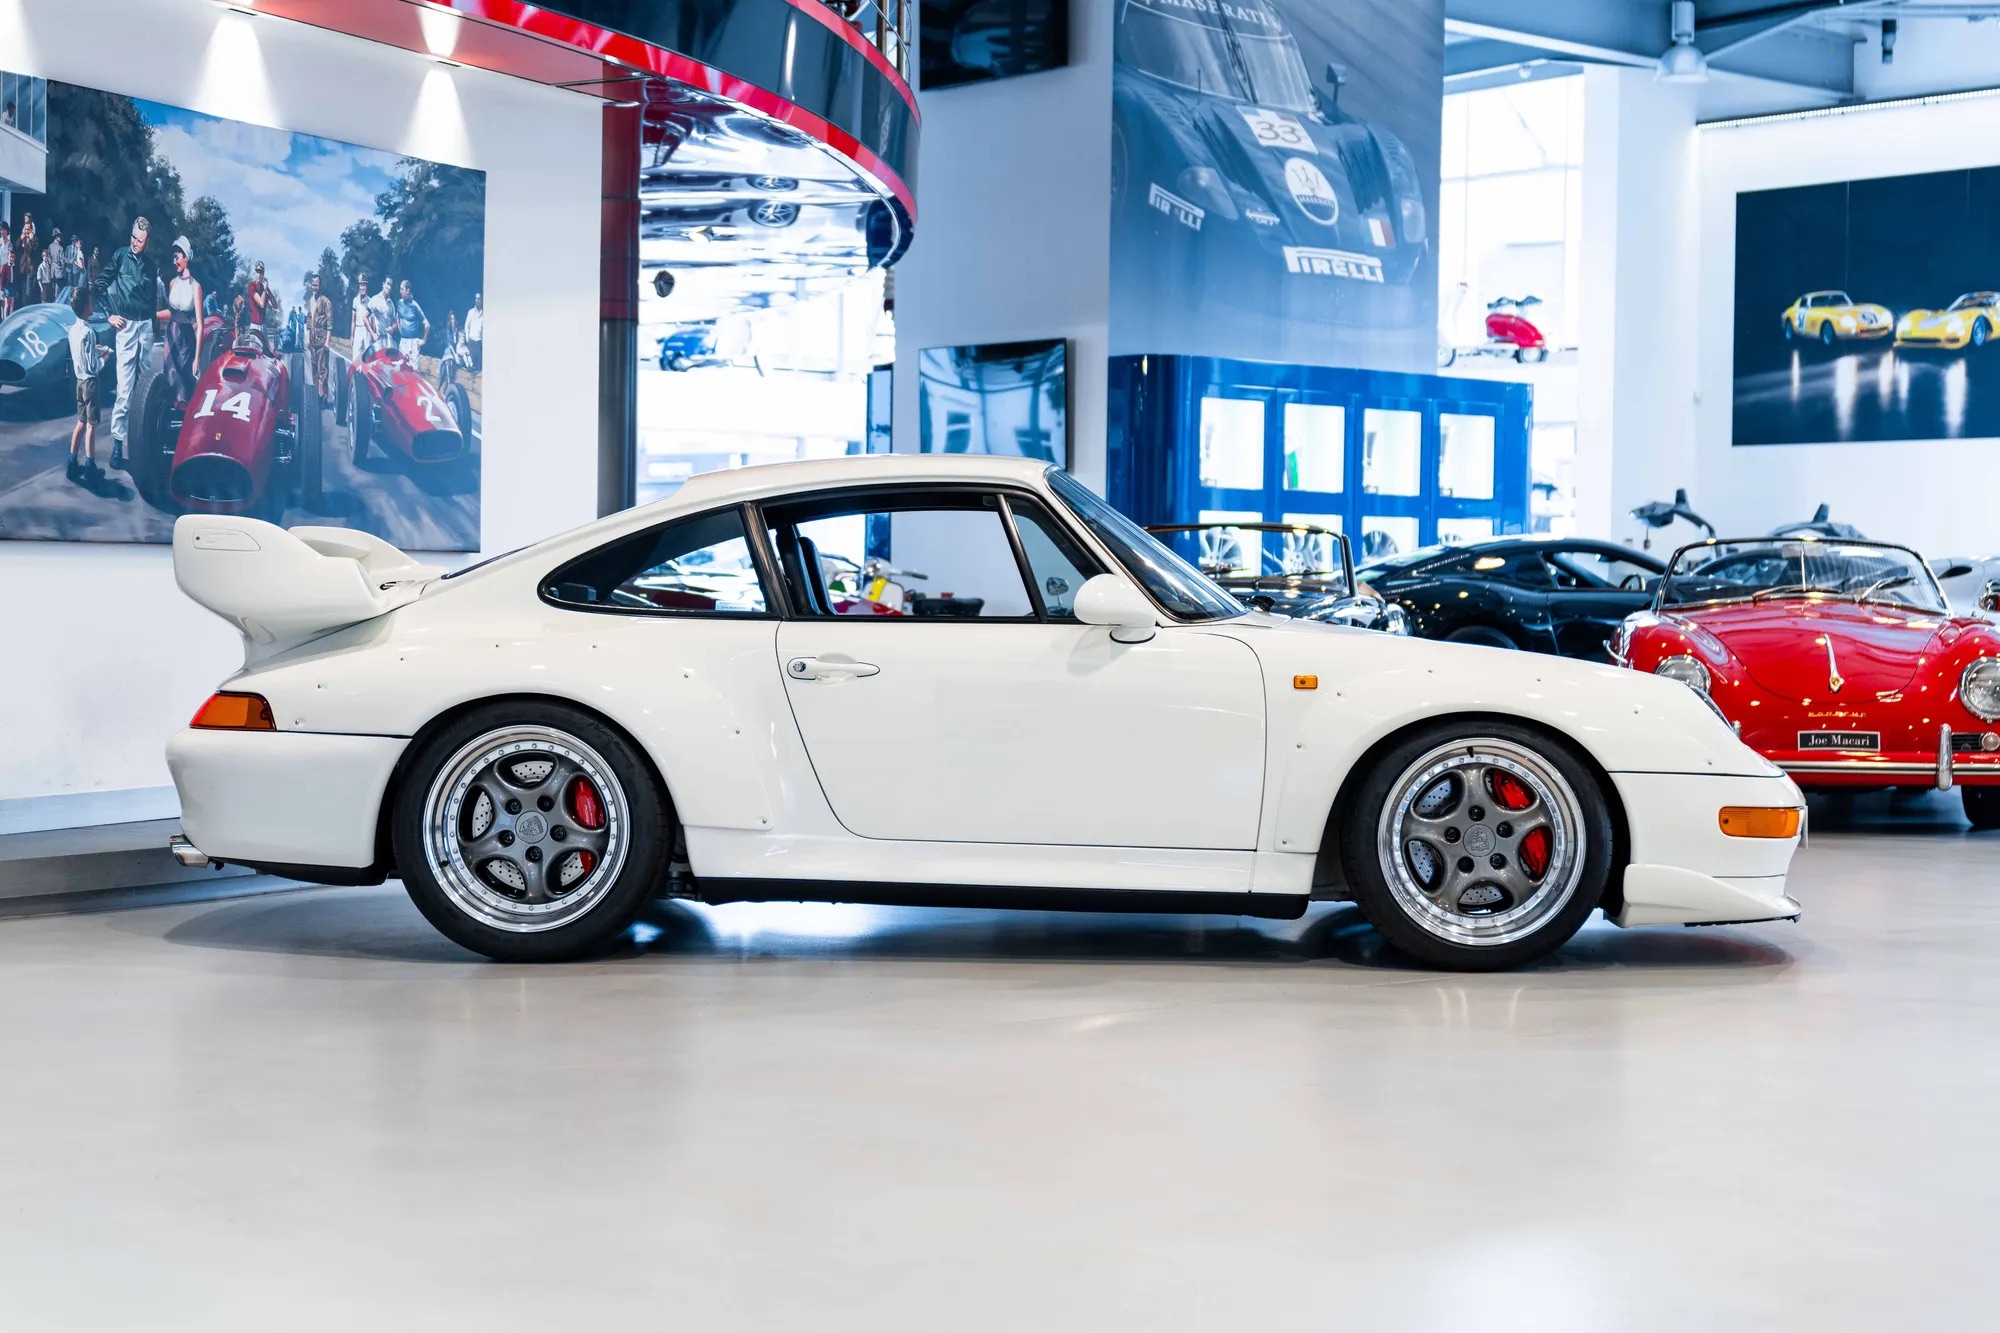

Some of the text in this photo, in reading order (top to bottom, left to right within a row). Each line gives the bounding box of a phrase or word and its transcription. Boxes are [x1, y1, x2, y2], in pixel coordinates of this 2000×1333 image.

[1255, 121, 1302, 144] 33
[1149, 182, 1205, 231] PIRLLI
[1282, 245, 1385, 284] PIRELLI
[17, 330, 48, 359] 18
[194, 389, 252, 422] 14
[1808, 734, 1870, 746] Joe Macari
